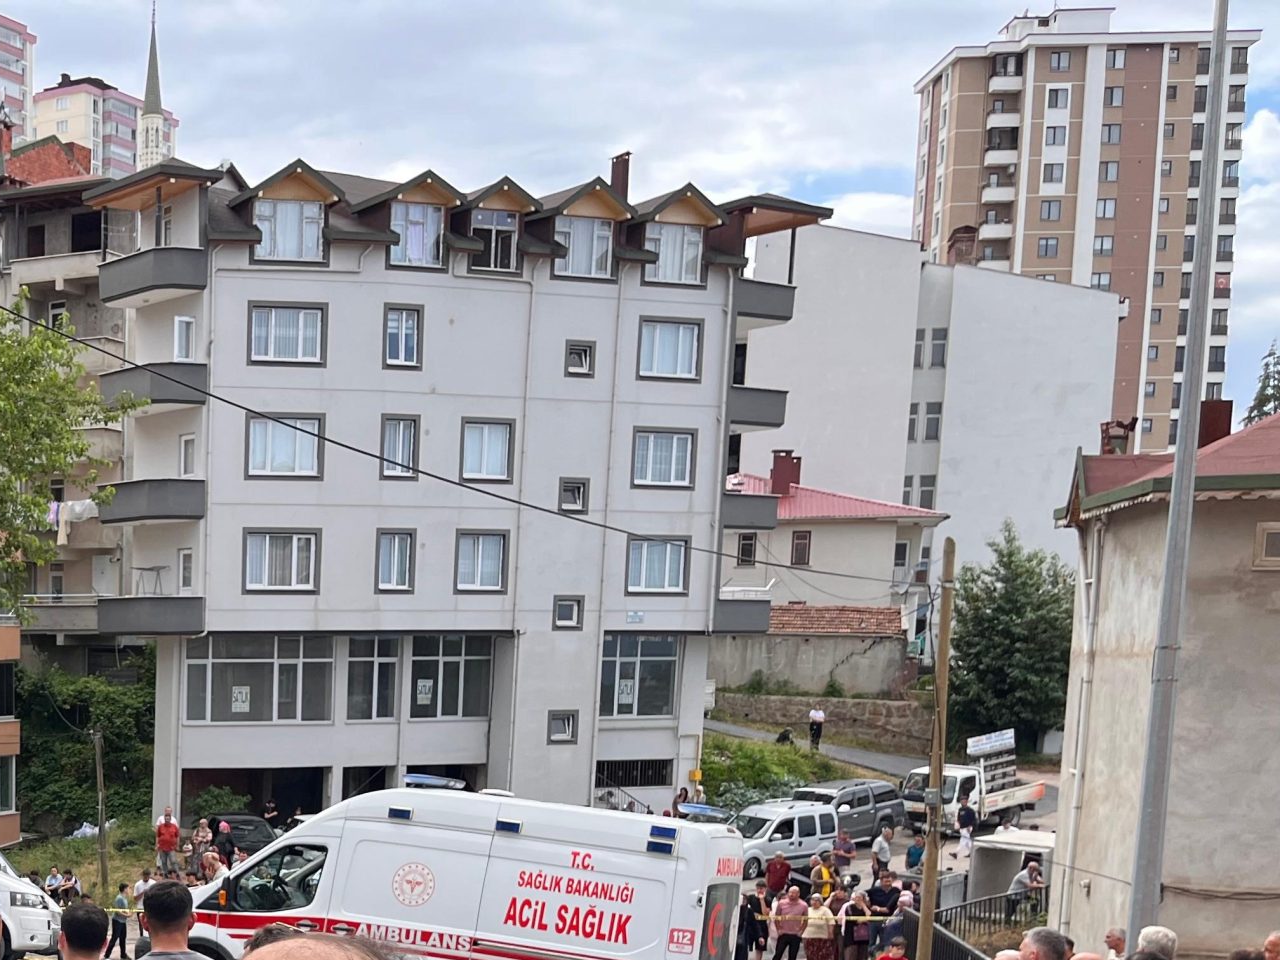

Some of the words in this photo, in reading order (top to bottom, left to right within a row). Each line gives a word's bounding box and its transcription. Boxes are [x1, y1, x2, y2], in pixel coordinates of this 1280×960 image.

[570, 851, 595, 871] T.C.
[517, 869, 563, 893] SAĞLIK
[566, 878, 635, 904] BAKANLIĞI
[354, 922, 471, 951] AMBULANS
[554, 904, 632, 945] SAĞLIK
[672, 930, 692, 945] 112
